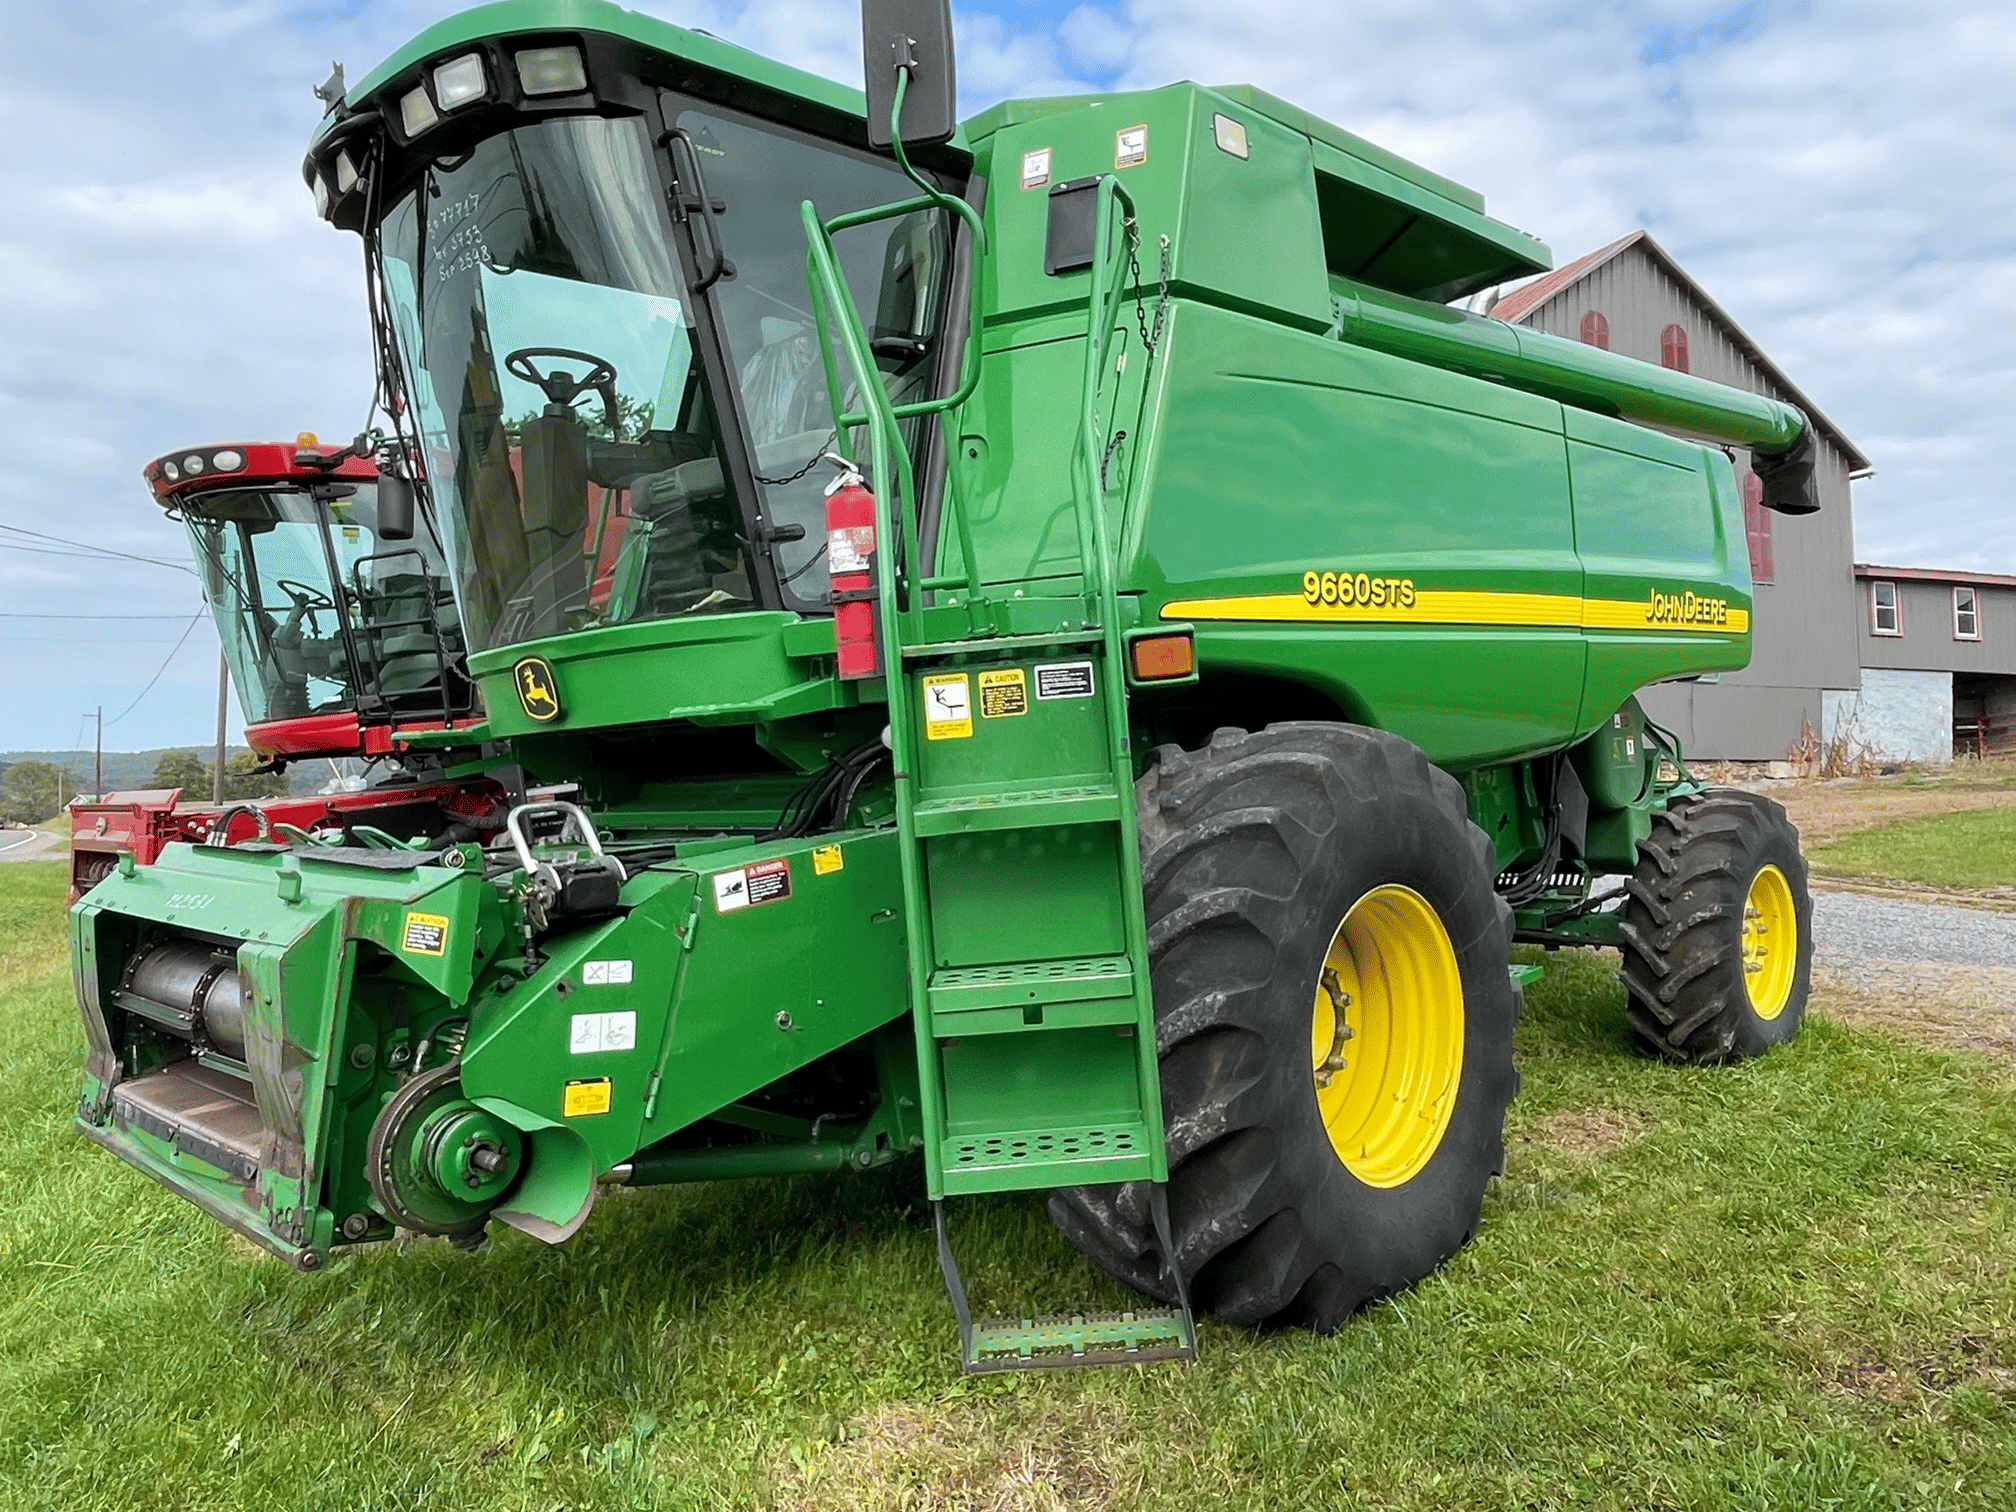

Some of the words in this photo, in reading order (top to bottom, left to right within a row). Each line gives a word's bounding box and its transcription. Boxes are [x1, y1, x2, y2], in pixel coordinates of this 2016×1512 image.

[458, 244, 491, 272] 2598
[1303, 571, 1415, 606] 9660STS
[994, 673, 1020, 683] CAUTION
